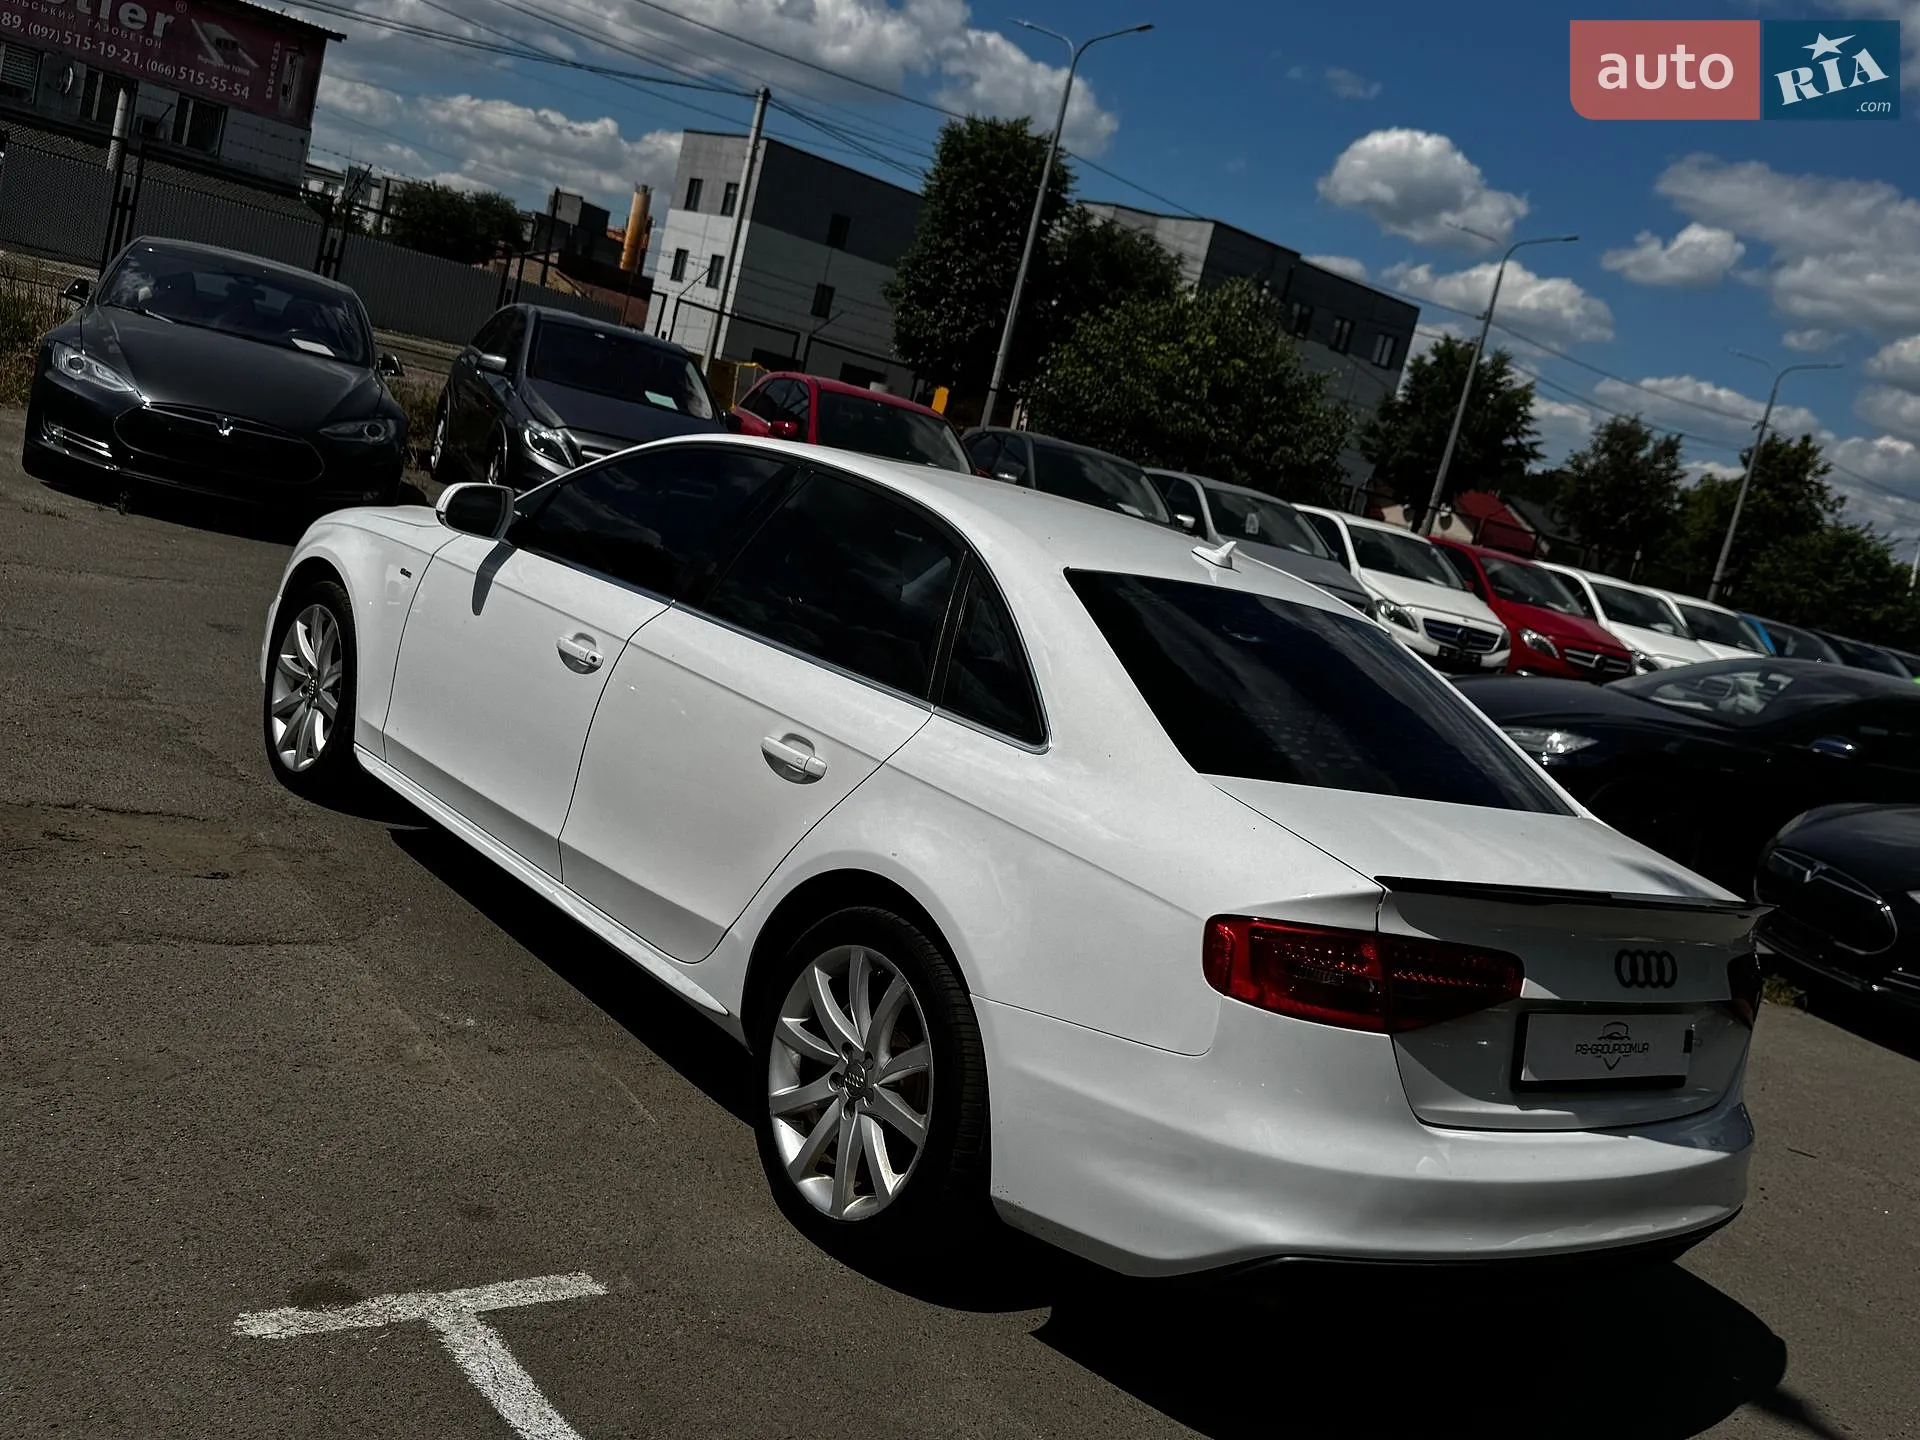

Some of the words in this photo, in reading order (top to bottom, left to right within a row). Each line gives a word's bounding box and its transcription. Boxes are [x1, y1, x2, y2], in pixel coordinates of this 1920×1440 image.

[28, 22, 60, 44] (097)
[62, 31, 143, 69] 515-19-21,
[146, 58, 176, 79] (066)
[178, 67, 251, 100] 515-55-54
